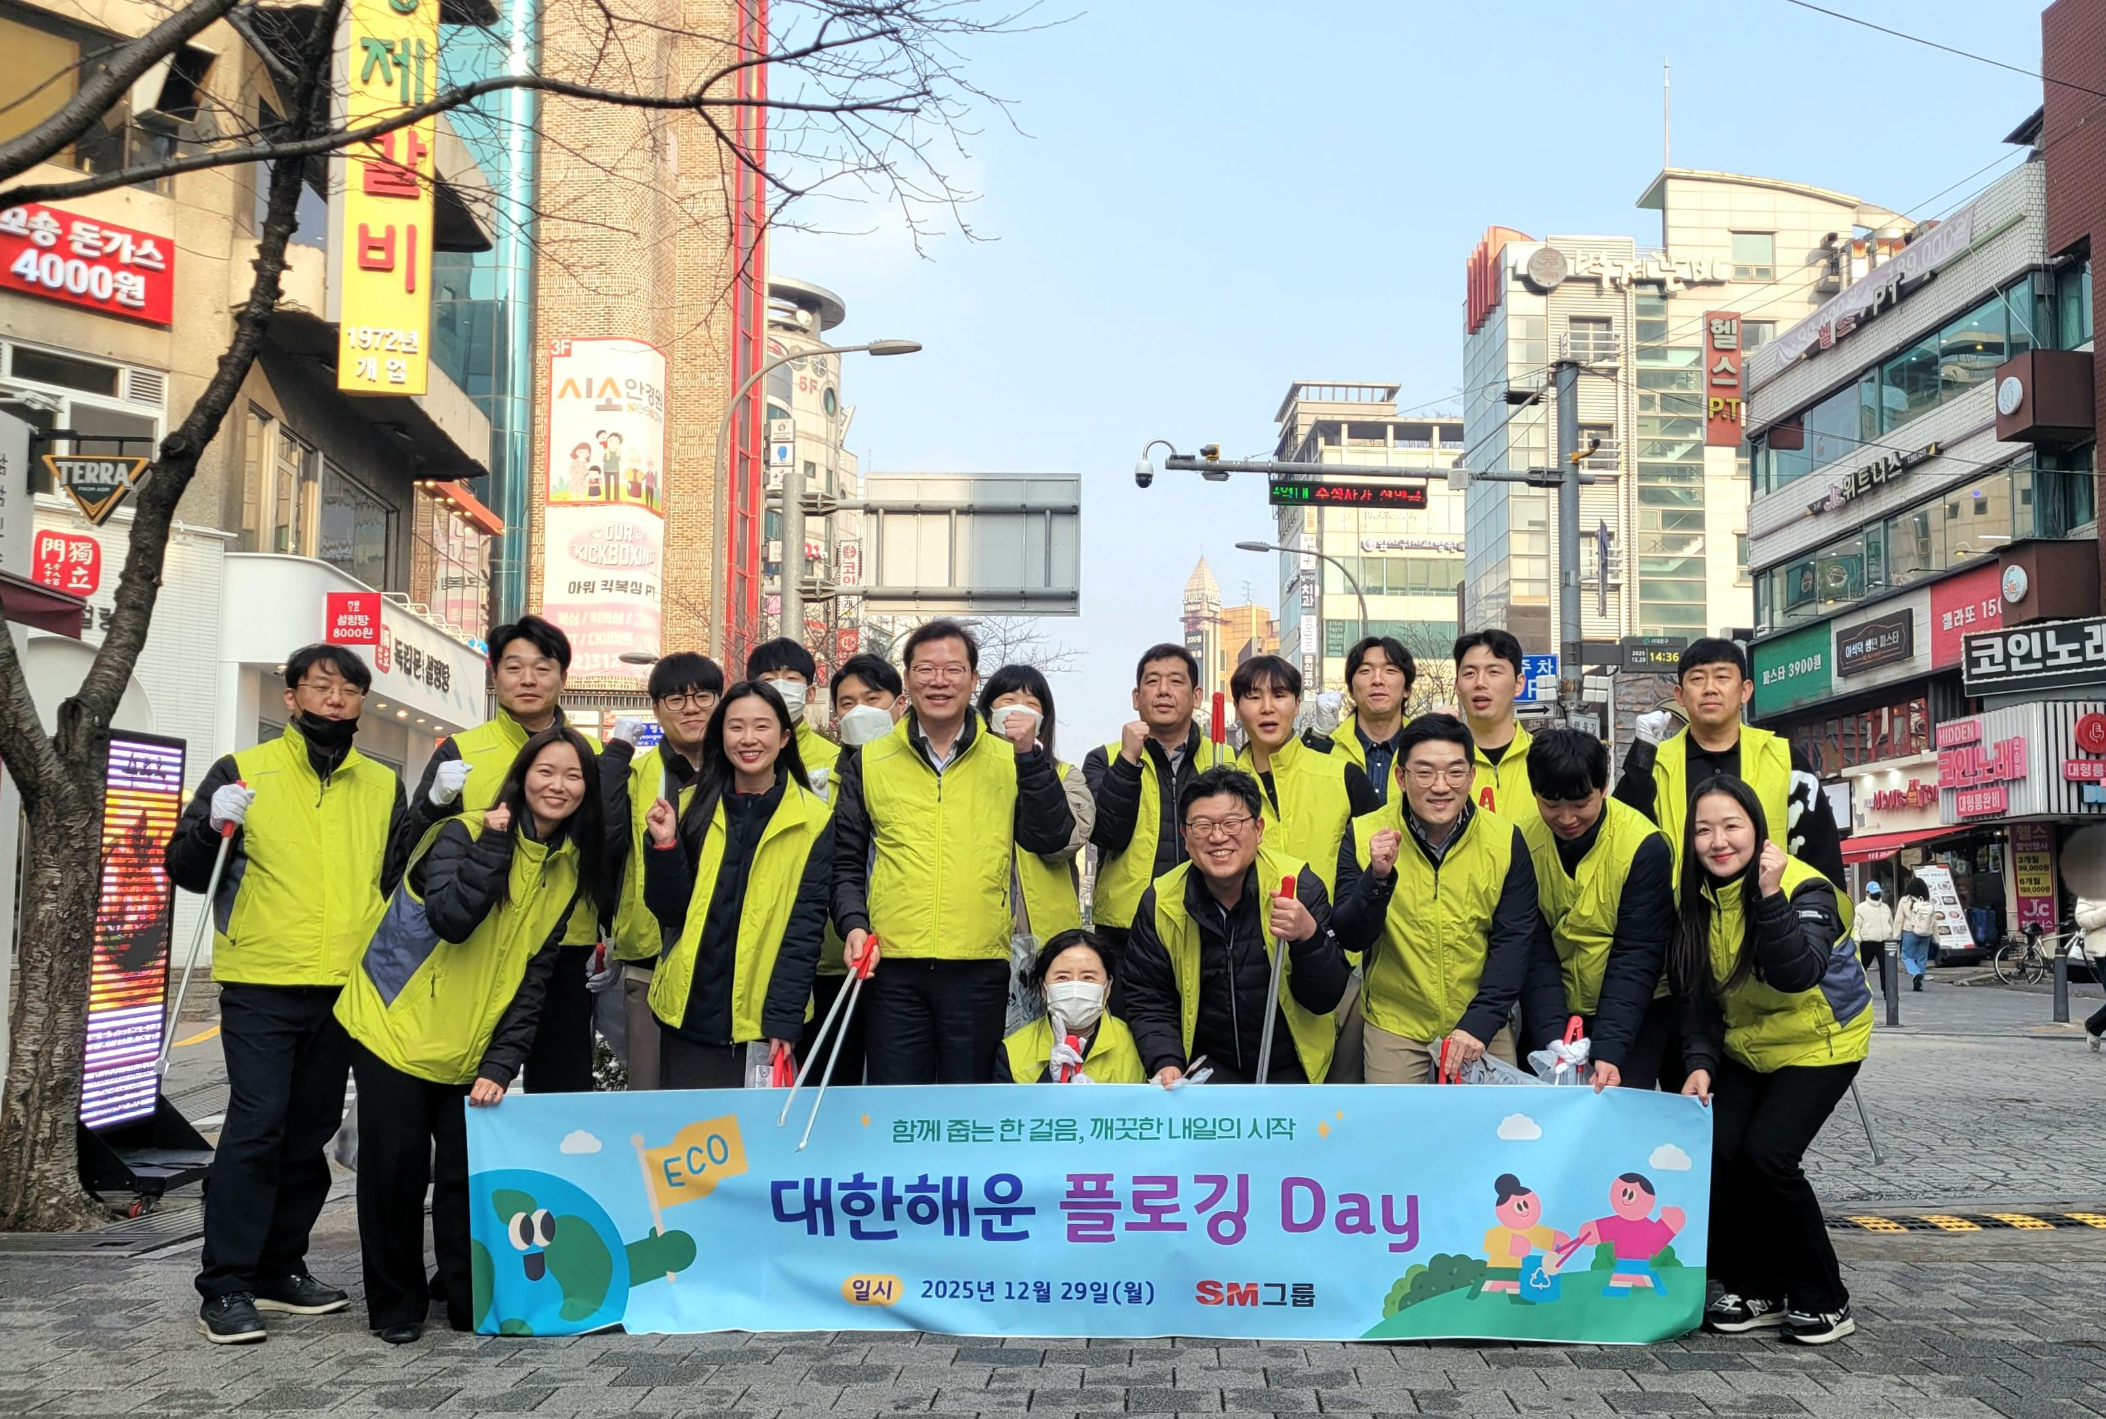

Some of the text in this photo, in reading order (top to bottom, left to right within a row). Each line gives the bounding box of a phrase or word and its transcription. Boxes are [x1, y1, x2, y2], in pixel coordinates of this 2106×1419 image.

[67, 220, 166, 270] 돈가스
[10, 248, 146, 307] 4000원
[347, 326, 419, 355] 1972년
[1818, 316, 1857, 350] 헬스
[550, 339, 571, 355] 3F
[1709, 318, 1738, 386] 헬스
[56, 461, 130, 486] TERRA
[606, 523, 634, 542] OUR
[573, 544, 657, 567] KICKBOXING
[568, 580, 656, 598] 아워 킥복싱 PT
[1301, 584, 1315, 606] 치과
[337, 614, 370, 626] 설렁탕
[1942, 605, 1976, 631] 젤라또
[333, 627, 373, 639] 8000원
[1879, 630, 1900, 648] 파스타
[1650, 651, 1680, 662] 14:36
[1763, 653, 1822, 685] 파스타 3900원
[1938, 723, 1975, 746] HIDDEN
[1938, 739, 2013, 789] 코인노래
[2067, 762, 2106, 778] 대형룸
[1958, 790, 2001, 813] 대형룸완비
[2016, 825, 2048, 840] 헬스
[2016, 842, 2048, 851] 할인행사
[2018, 855, 2040, 864] 3개월
[2018, 864, 2050, 873] 99,000원
[2020, 886, 2051, 894] 189,000원
[892, 1116, 1296, 1145] 함께 줍는 한 걸음, 깨끗한 내일의 시작
[662, 1133, 729, 1189] ECO
[770, 1171, 1420, 1253] 대한해운 플로깅 Day
[852, 1279, 893, 1302] 일시
[921, 1280, 1155, 1305] 2025년 12월 29일(월)
[1195, 1280, 1316, 1308] SM그룹
